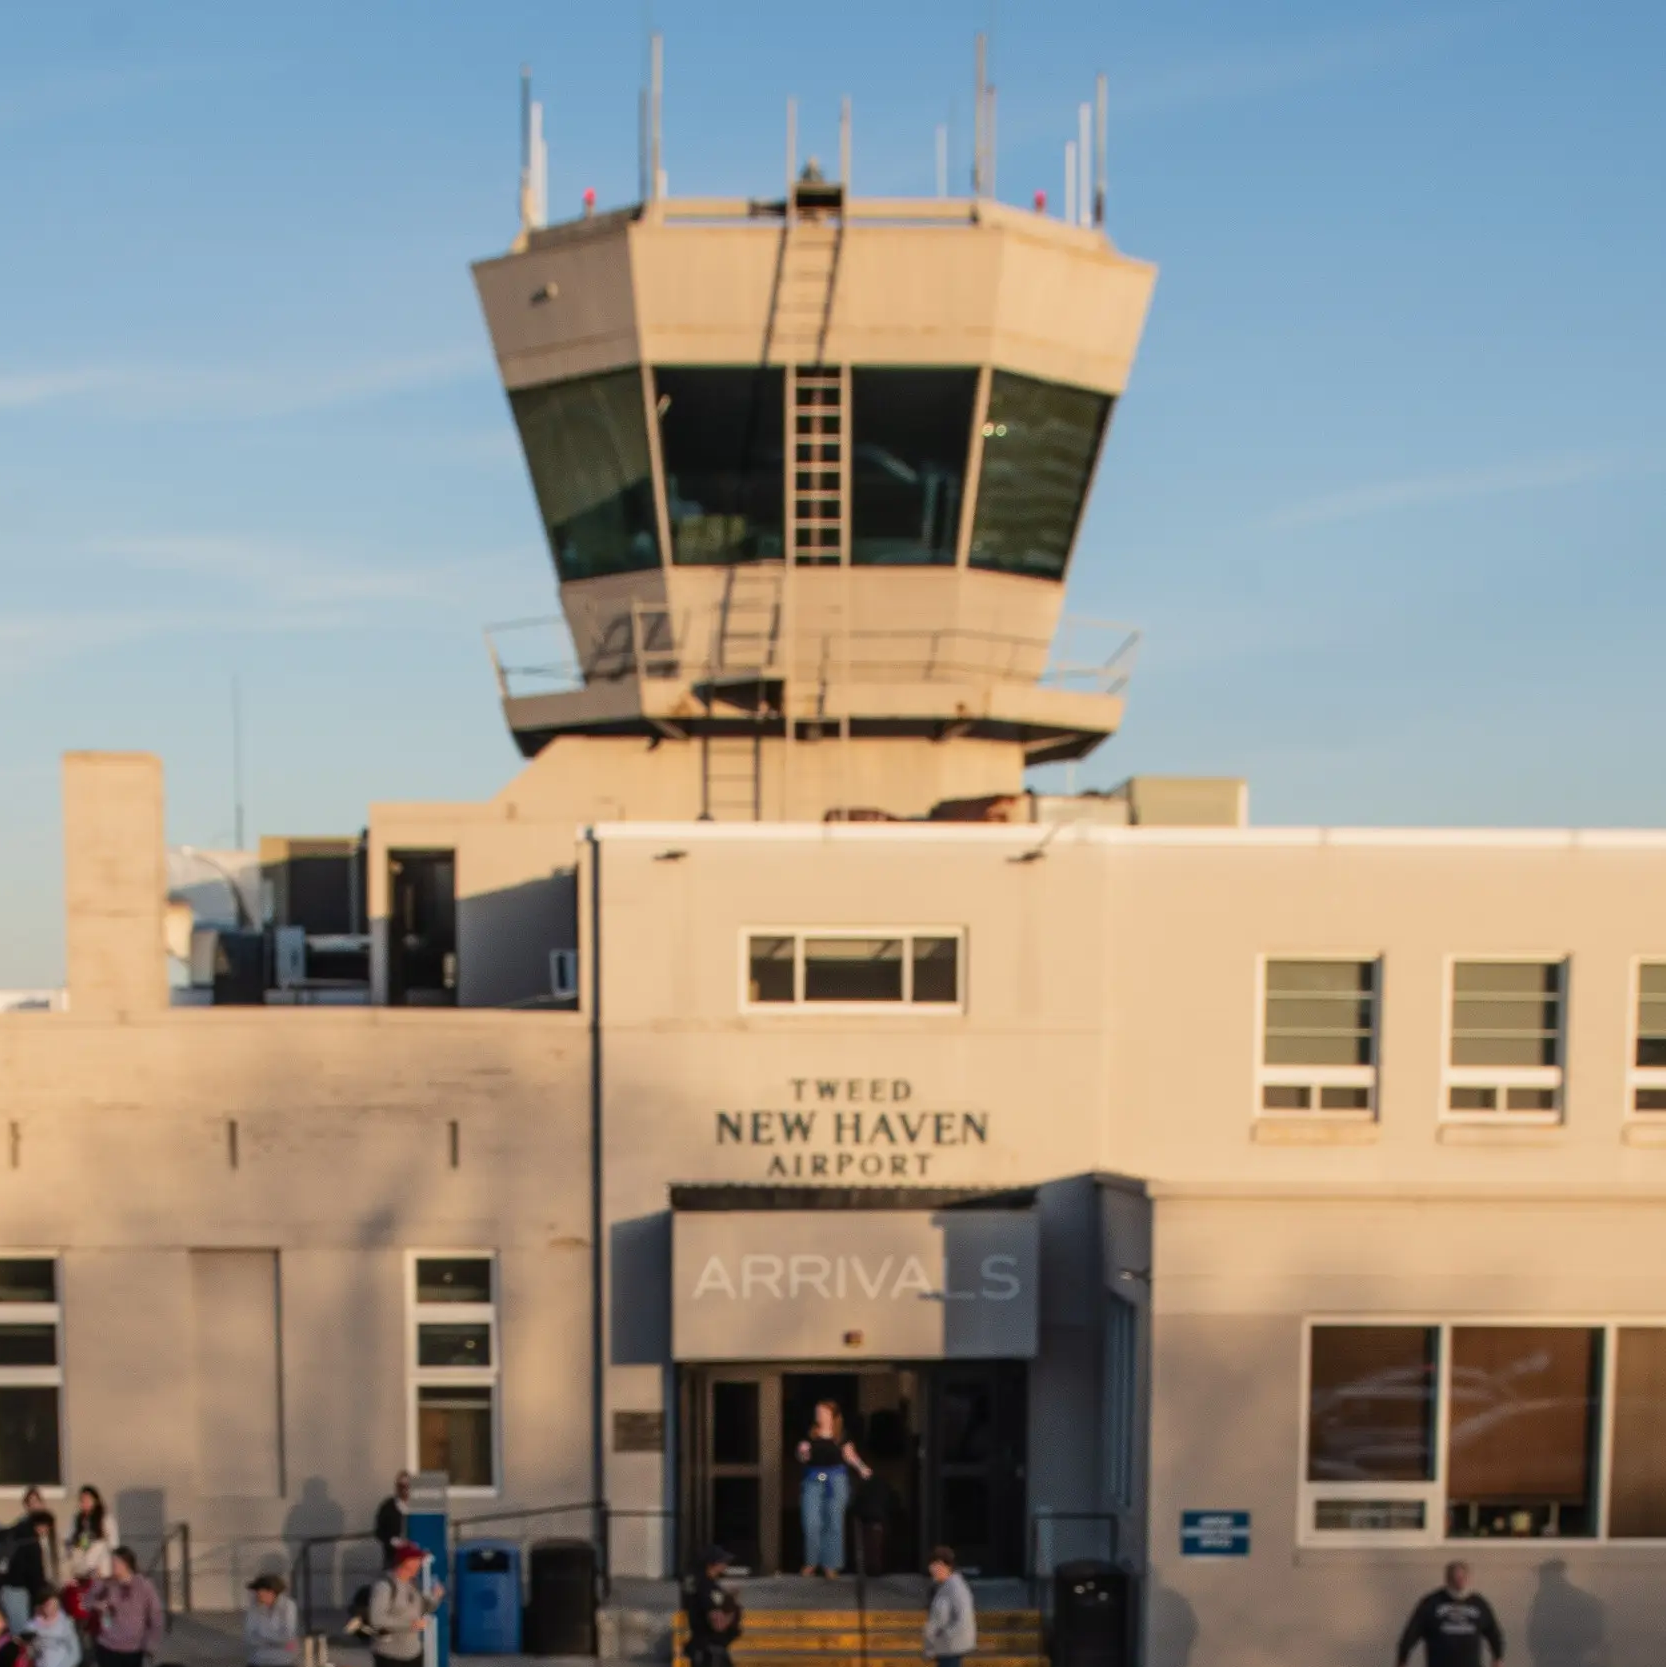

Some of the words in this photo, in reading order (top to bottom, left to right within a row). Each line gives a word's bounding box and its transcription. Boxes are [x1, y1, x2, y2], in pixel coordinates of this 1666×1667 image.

[791, 1078, 913, 1102] TWEED
[715, 1111, 815, 1146] NEW
[834, 1112, 990, 1146] HAVEN
[766, 1153, 933, 1178] AIRPORT
[691, 1254, 1021, 1300] ARRIVALS
